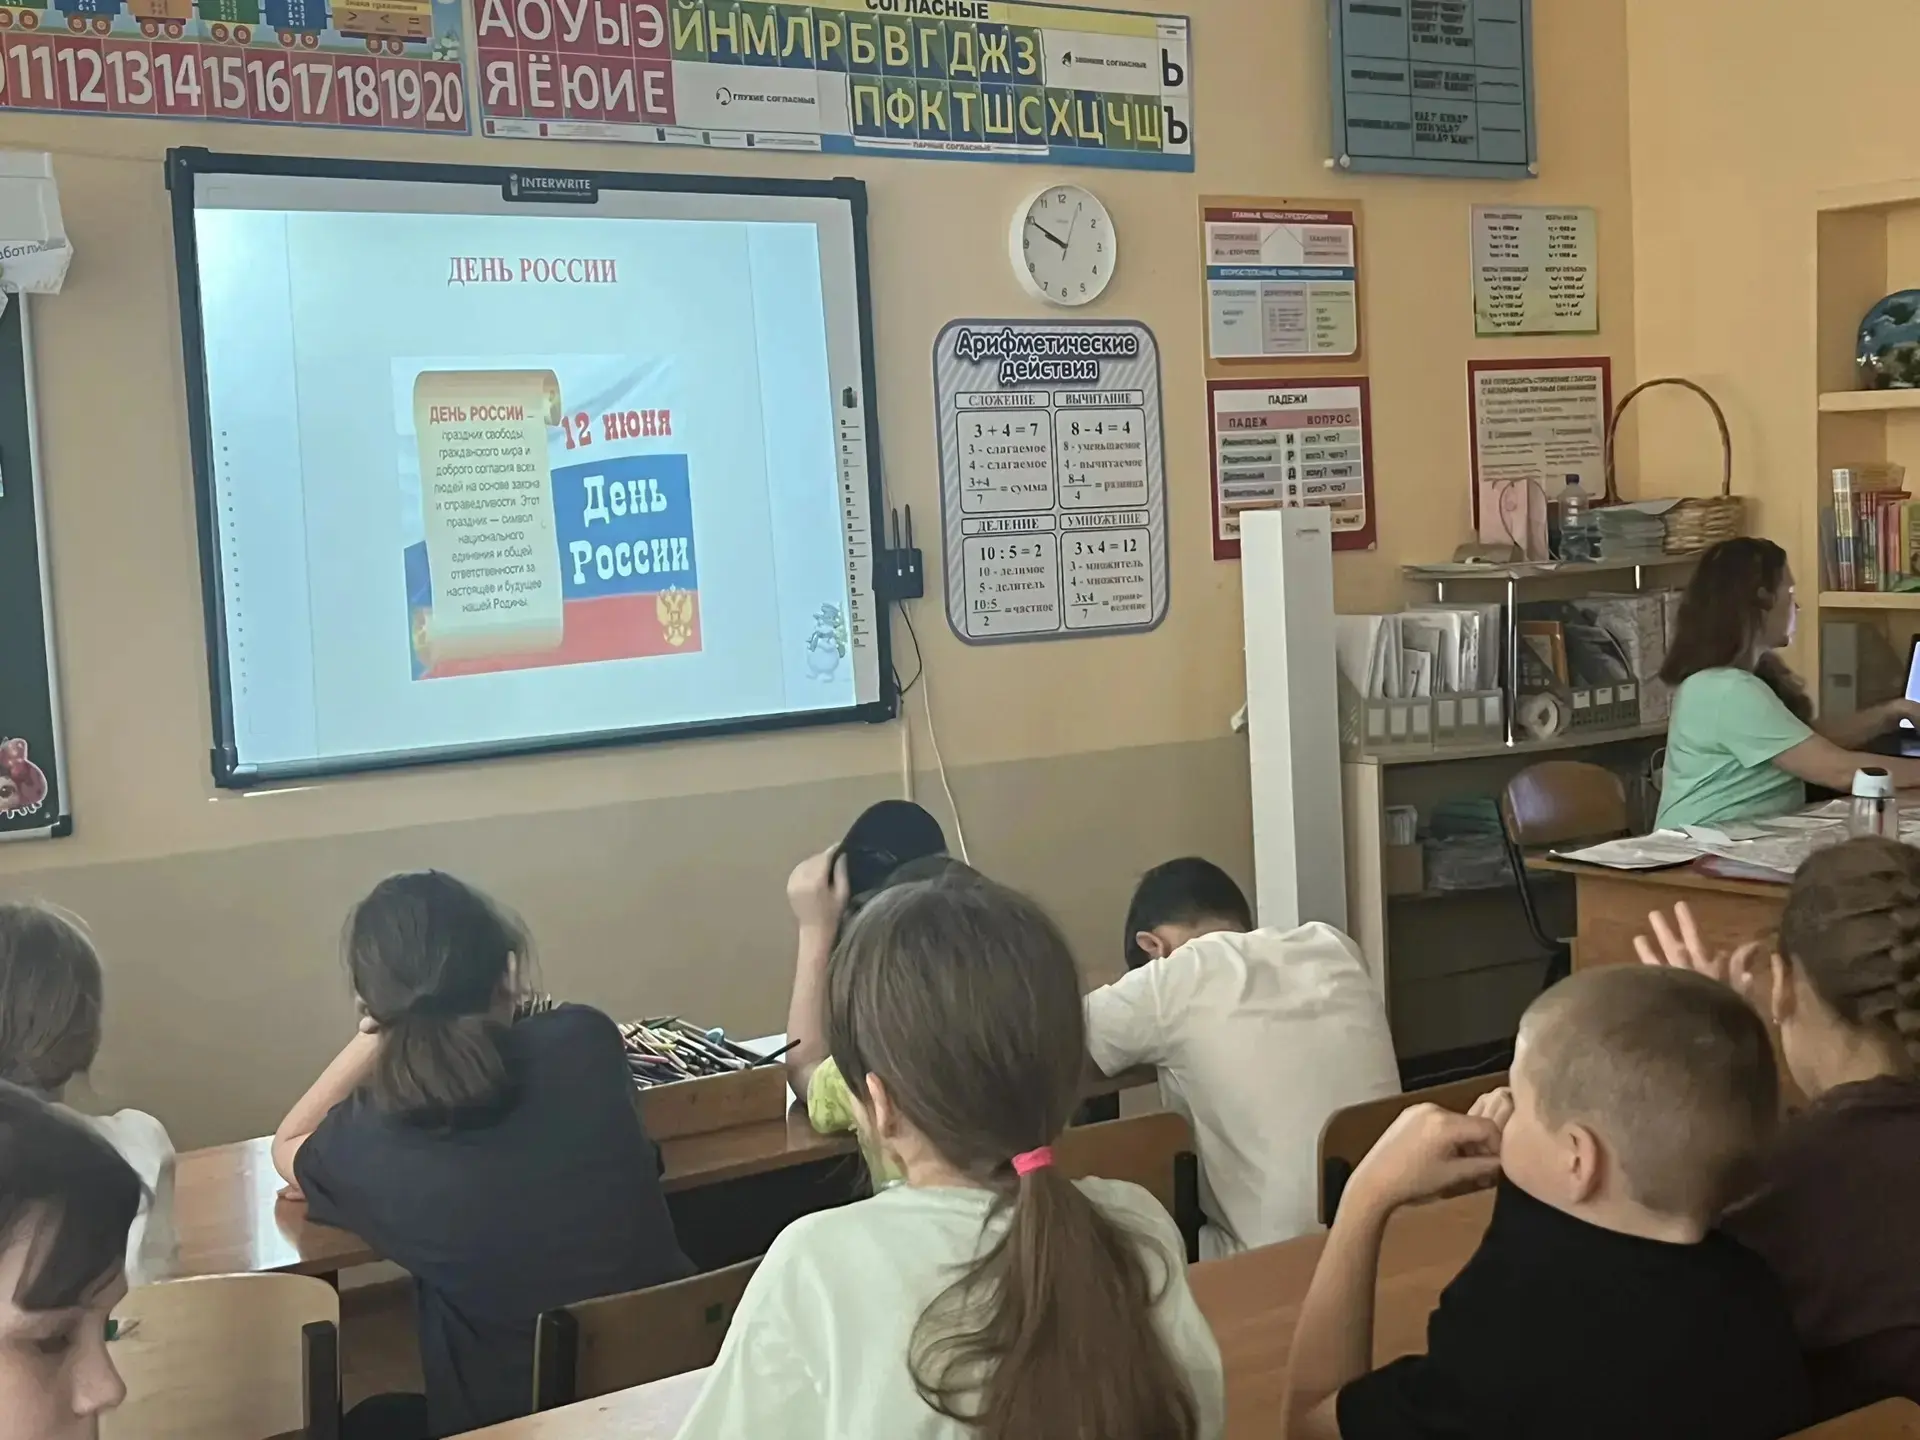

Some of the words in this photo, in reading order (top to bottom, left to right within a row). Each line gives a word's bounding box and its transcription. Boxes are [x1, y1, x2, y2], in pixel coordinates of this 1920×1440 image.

[1162, 48, 1184, 87] Ь
[9, 44, 54, 101] 11
[58, 47, 106, 103] 12
[106, 49, 153, 104] 13
[154, 53, 201, 107] 14
[203, 55, 246, 109] 15
[247, 60, 290, 113] 16
[292, 63, 333, 116] 17
[337, 65, 379, 118] 18
[381, 68, 419, 120] 19
[424, 71, 463, 123] 20
[1164, 106, 1188, 145] Ъ
[522, 177, 591, 189] INTERWRITE
[1058, 194, 1066, 204] 12
[1091, 219, 1096, 228] 2
[1096, 242, 1102, 252] 3
[448, 257, 513, 286] ДЕНЬ
[519, 258, 617, 283] РОССИИ
[1092, 265, 1097, 275] 4
[1043, 281, 1048, 291] 7
[1061, 288, 1068, 297] 6
[956, 328, 1139, 359] Арифметические
[999, 357, 1099, 382] действия
[968, 394, 1036, 406] СЛОЖЕНИЕ
[1065, 393, 1132, 405] ВЫЧИТАНИЕ
[1268, 394, 1308, 405] ПАДЕЖИ
[430, 406, 466, 425] ДЕНЬ
[470, 405, 524, 421] РОССИИ
[1229, 416, 1268, 428] ПАДЕЖ
[1307, 414, 1352, 425] ВОПРОС
[561, 412, 592, 450] 12
[974, 424, 982, 438] 3
[1002, 423, 1011, 437] 4
[1030, 423, 1038, 436] 7
[1071, 421, 1080, 435] 8
[1095, 421, 1104, 434] 4
[1122, 421, 1131, 434] 4
[442, 430, 482, 441] праздник
[439, 447, 499, 460] гражданского
[986, 445, 1047, 455] слагаемое
[1287, 450, 1294, 460] Р
[436, 463, 473, 476] доброго
[475, 464, 514, 474] согласия
[516, 463, 536, 473] всех
[987, 459, 1047, 469] слагаемое
[466, 482, 477, 492] на
[479, 480, 510, 491] основе
[512, 480, 540, 490] закона
[1289, 484, 1297, 495] В
[521, 494, 540, 507] Этот
[583, 475, 668, 528] День
[446, 516, 488, 528] праздник
[501, 513, 534, 524] символ
[977, 517, 1039, 533] ДЕЛЕНИЕ
[1067, 513, 1142, 527] УМНОЖЕНИЕ
[458, 531, 525, 545] национального
[980, 546, 995, 561] 10
[1009, 545, 1017, 559] 5
[1035, 544, 1043, 557] 2
[1074, 541, 1083, 556] 3
[1098, 540, 1106, 553] 4
[1123, 538, 1137, 552] 12
[452, 550, 494, 563] единения
[569, 537, 690, 585] России
[451, 564, 524, 580] ответственности
[526, 563, 536, 573] за
[446, 583, 496, 597] настоящее
[505, 579, 542, 594] будущее
[462, 598, 492, 613] нашей
[1013, 602, 1054, 614] частное
[984, 616, 990, 626] 2
